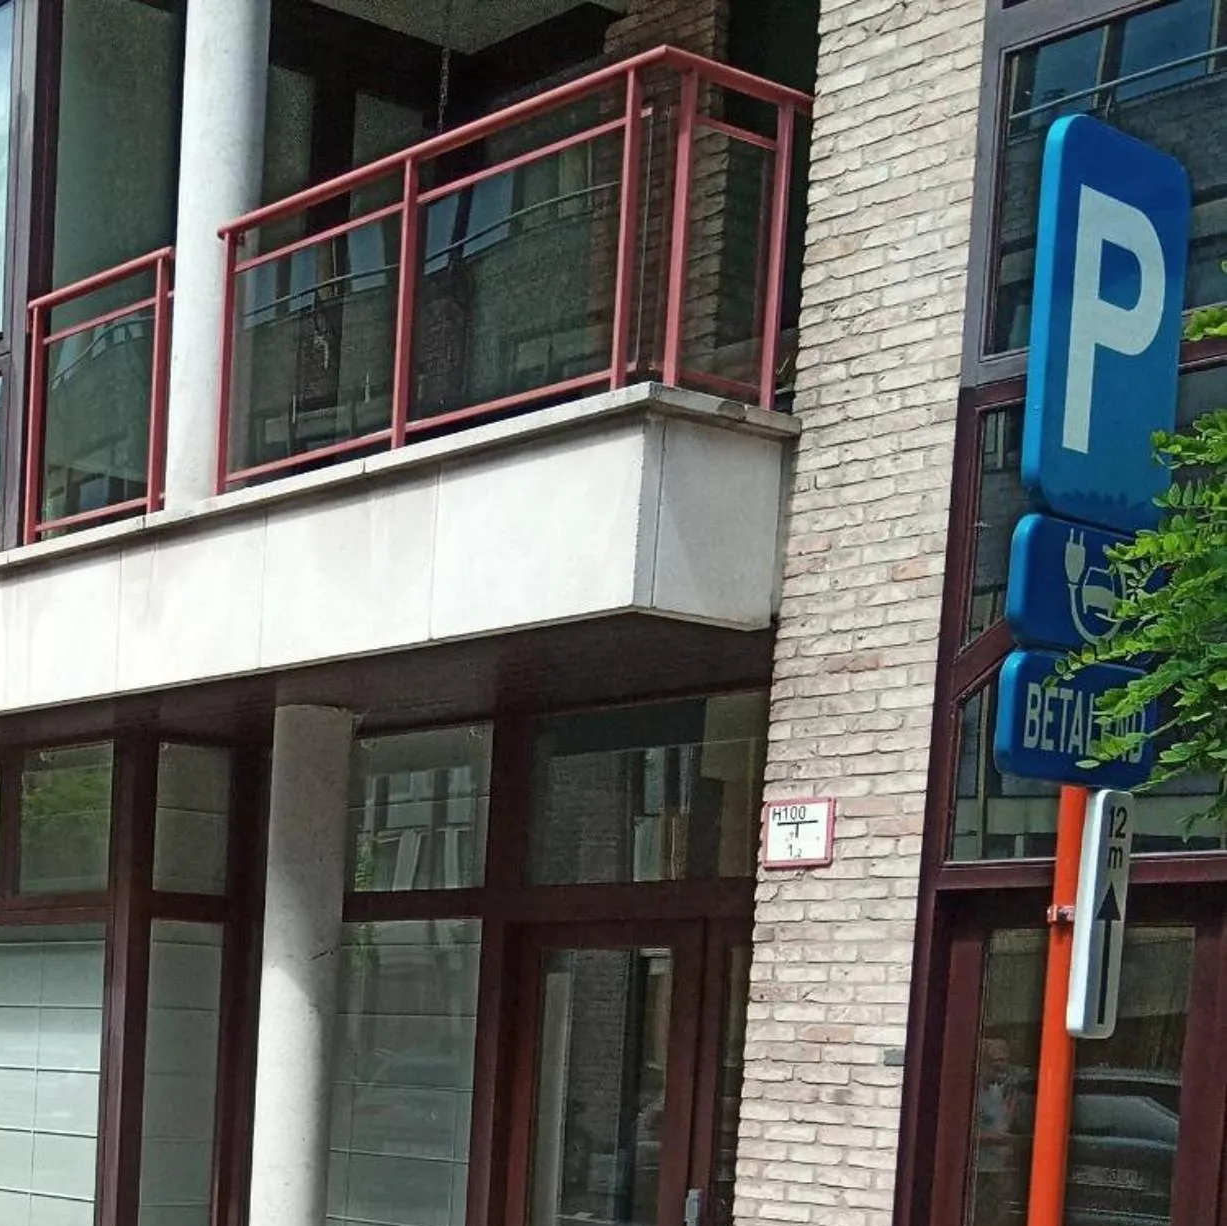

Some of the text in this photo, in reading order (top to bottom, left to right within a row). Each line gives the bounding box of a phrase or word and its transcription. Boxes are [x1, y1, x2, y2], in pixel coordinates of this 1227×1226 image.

[1062, 183, 1166, 454] P
[772, 806, 806, 821] H100
[1108, 805, 1128, 839] 12
[1106, 846, 1124, 870] m
